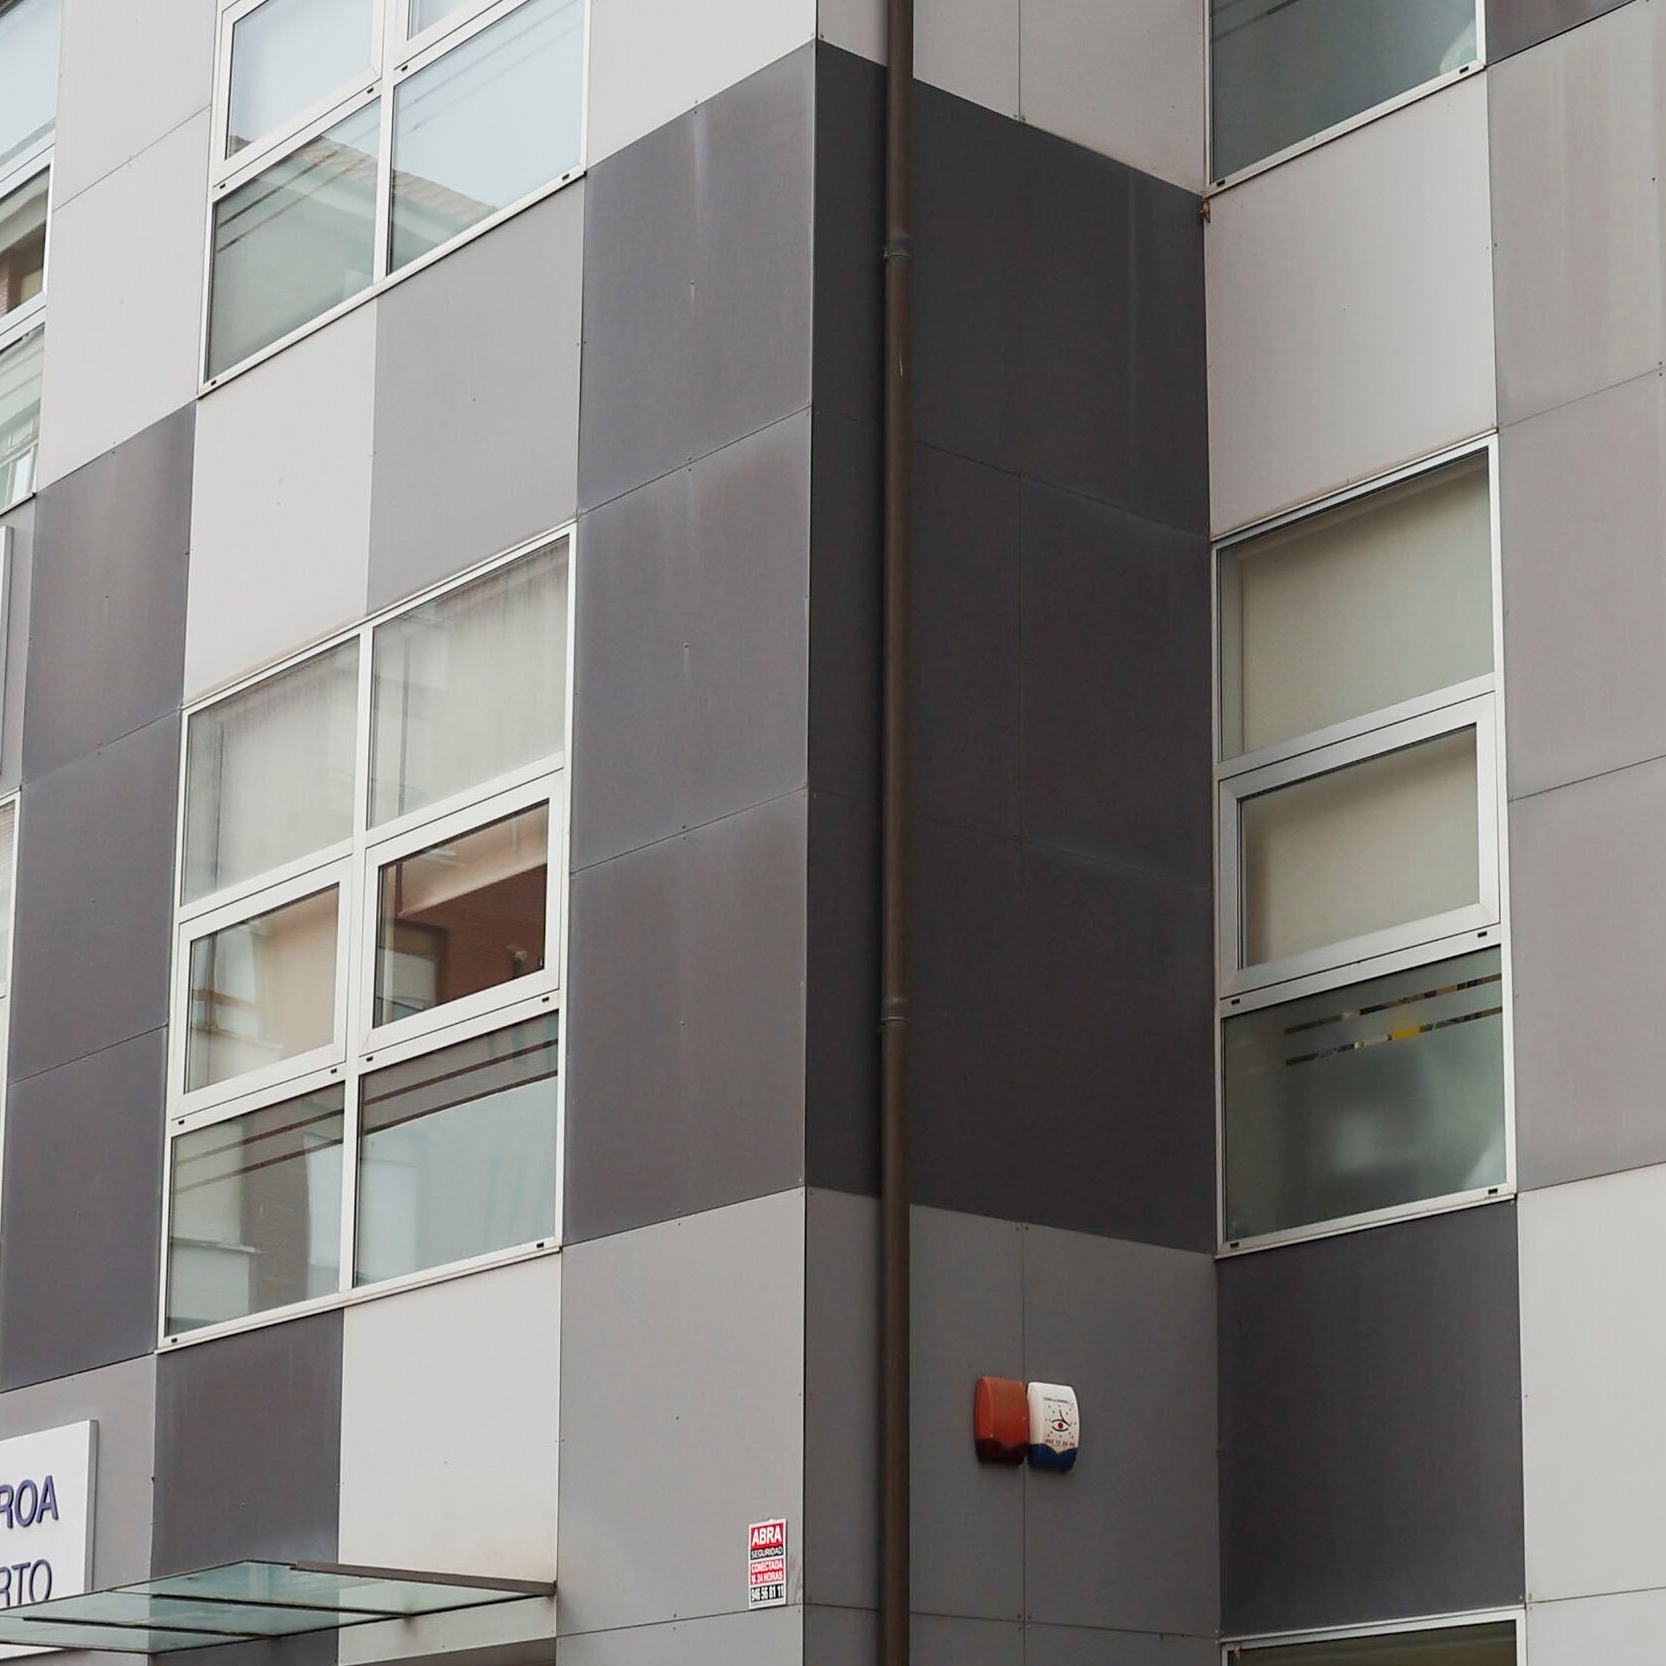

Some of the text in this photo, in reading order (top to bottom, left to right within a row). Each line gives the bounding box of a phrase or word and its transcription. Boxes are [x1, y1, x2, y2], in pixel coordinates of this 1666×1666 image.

[752, 1525, 782, 1547] ABRA
[751, 1547, 783, 1558] SEGURIDAD
[751, 1560, 783, 1573] CONECTADA
[764, 1571, 783, 1582] HORAS
